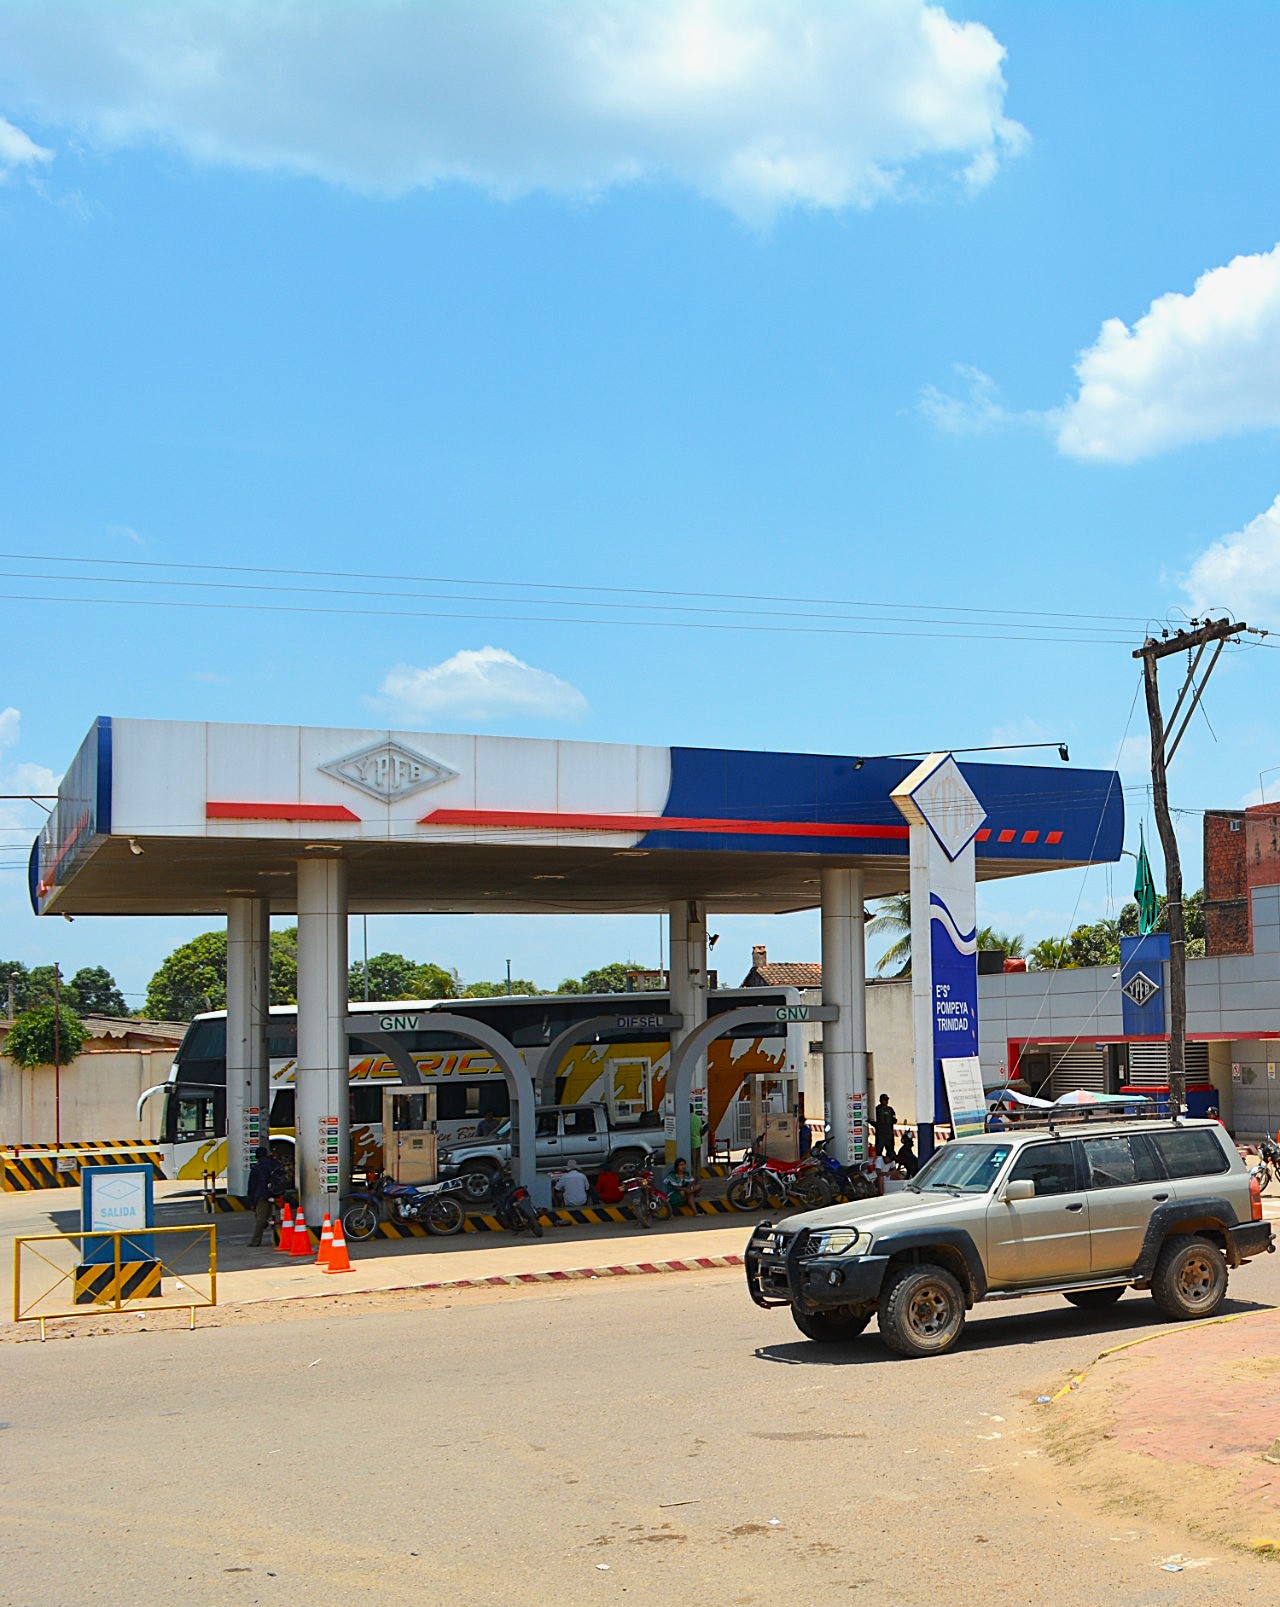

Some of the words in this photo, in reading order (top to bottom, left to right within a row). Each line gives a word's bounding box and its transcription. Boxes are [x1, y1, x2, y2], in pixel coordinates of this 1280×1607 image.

[355, 754, 424, 788] YPFB
[1130, 979, 1150, 1000] YPFB
[776, 1007, 808, 1020] GNV
[936, 1001, 969, 1015] POMPEYA
[380, 1017, 419, 1030] GNV
[937, 1017, 969, 1031] TRINIDAD
[100, 1207, 136, 1217] SALIDA
